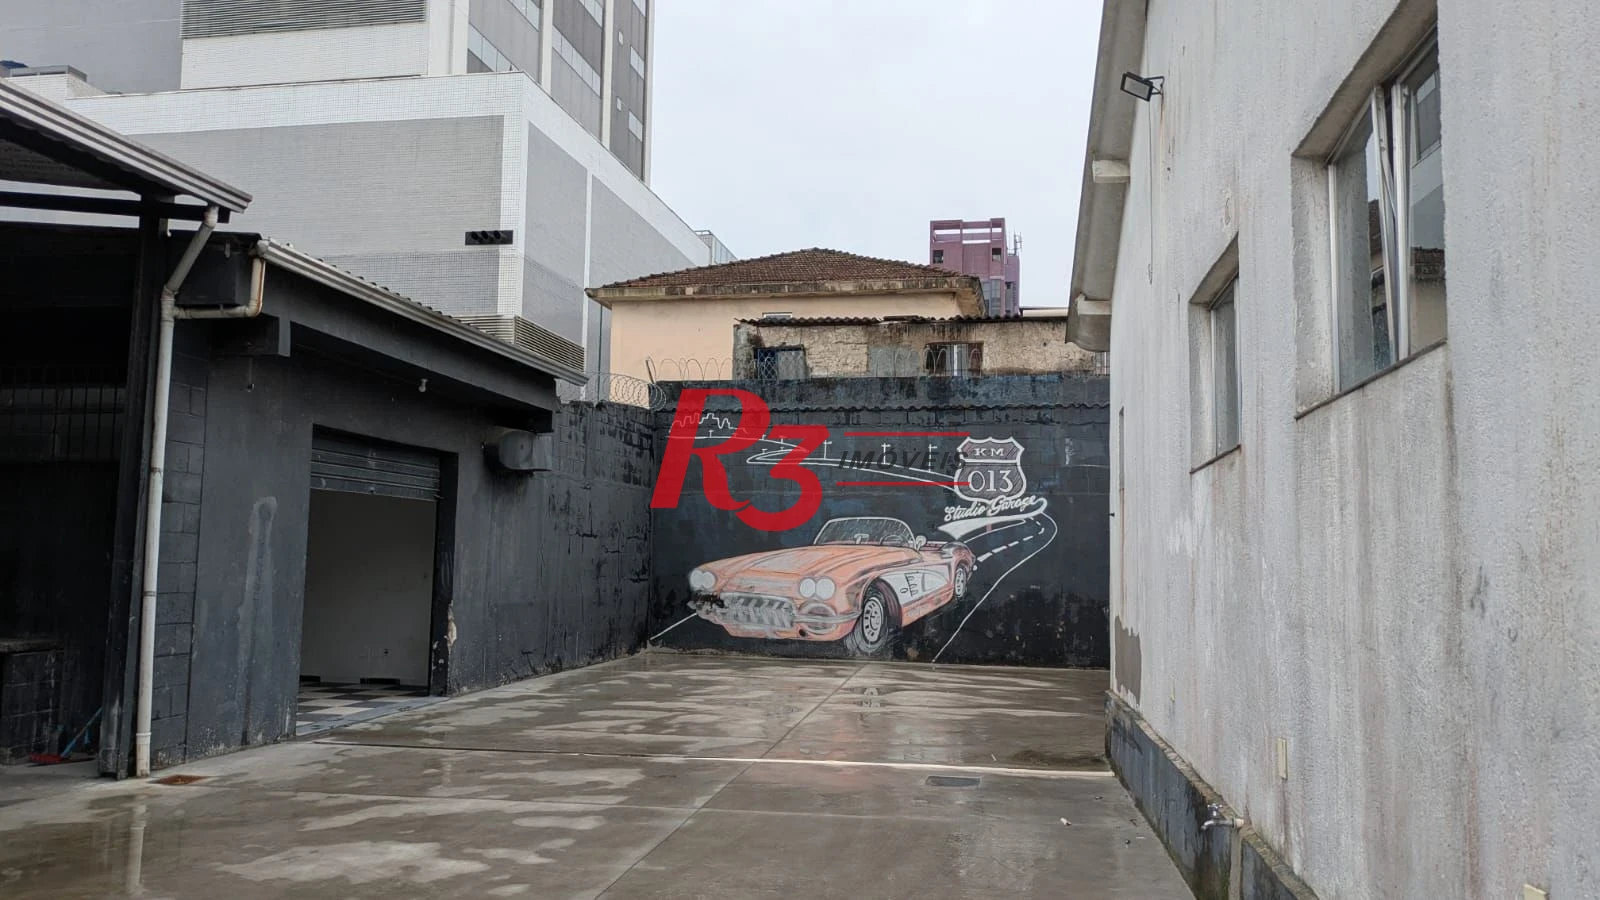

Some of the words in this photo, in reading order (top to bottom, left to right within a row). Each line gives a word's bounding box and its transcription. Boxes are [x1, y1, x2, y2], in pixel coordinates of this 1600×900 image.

[974, 447, 1005, 457] KM
[967, 470, 1014, 493] 013
[944, 501, 986, 521] Studio
[986, 494, 1037, 516] Garage
